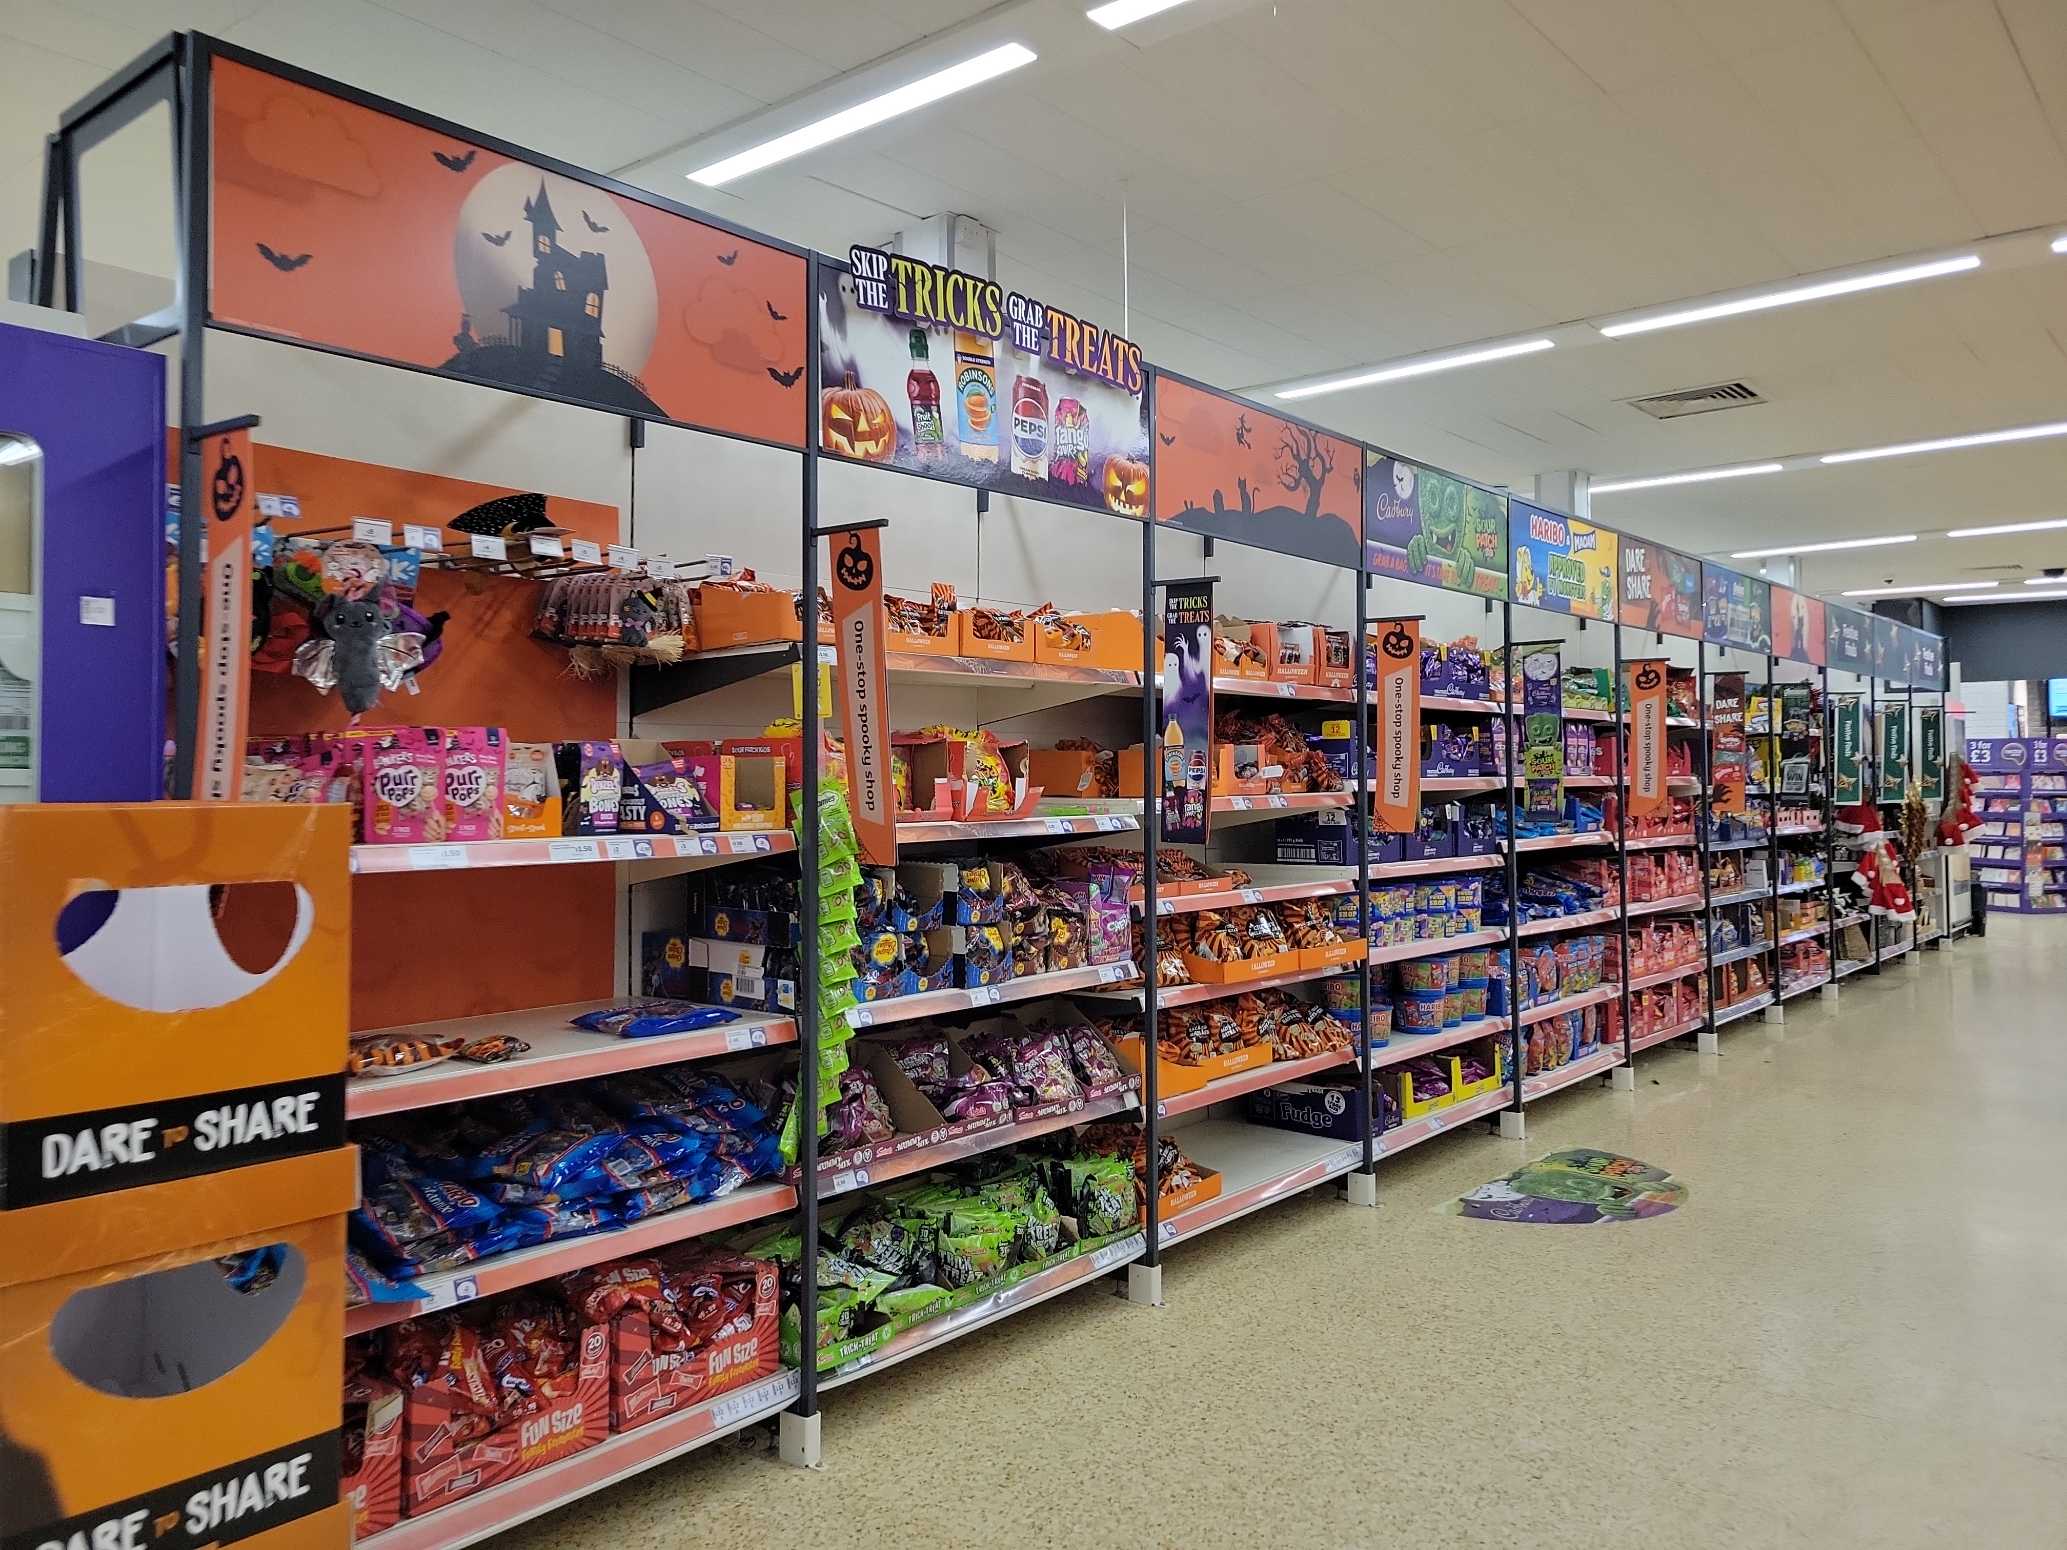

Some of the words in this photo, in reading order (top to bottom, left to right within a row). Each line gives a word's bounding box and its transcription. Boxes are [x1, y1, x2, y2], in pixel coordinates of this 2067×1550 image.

[851, 250, 888, 280] SKIP
[855, 279, 889, 310] THE
[891, 257, 1003, 337] TRICKS
[1008, 295, 1044, 328] GRAB
[1013, 321, 1040, 352] THE
[1046, 308, 1143, 393] TREATS
[1013, 417, 1048, 439] PEPSI
[1376, 492, 1414, 525] Cadbury
[1530, 514, 1566, 547] HARIBO
[1574, 533, 1596, 552] MAOAM
[1548, 551, 1585, 584] APPROVED
[1625, 548, 1646, 573] DARE
[1626, 575, 1652, 600] SHARE
[1179, 596, 1208, 610] TRICKS
[1179, 610, 1210, 624] TREATS
[854, 619, 868, 700] One-stop
[1393, 677, 1405, 729] One-stop
[1715, 698, 1740, 710] DARE
[1643, 703, 1653, 741] One-stop
[1714, 712, 1744, 724] SHARE
[859, 704, 873, 770] spooky
[1392, 730, 1404, 771] spooky
[1969, 741, 1977, 750] 3
[1642, 742, 1653, 772] spooky
[1970, 749, 1991, 762] £3
[2033, 749, 2048, 763] £3
[380, 769, 419, 796] Purr
[864, 771, 876, 812] shop
[1391, 772, 1403, 799] shop
[1642, 772, 1653, 793] shop
[620, 805, 647, 822] ASTY
[1280, 1102, 1333, 1129] Fudge
[41, 1118, 159, 1179] DARE
[193, 1091, 321, 1152] SHARE
[761, 1278, 773, 1290] 20
[587, 1338, 601, 1349] 20
[708, 1346, 733, 1376] FUN
[732, 1337, 759, 1364] Size
[839, 1342, 860, 1359] TRICK
[520, 1419, 550, 1448] FUN
[551, 1402, 584, 1434] Size
[185, 1453, 314, 1536] SHARE
